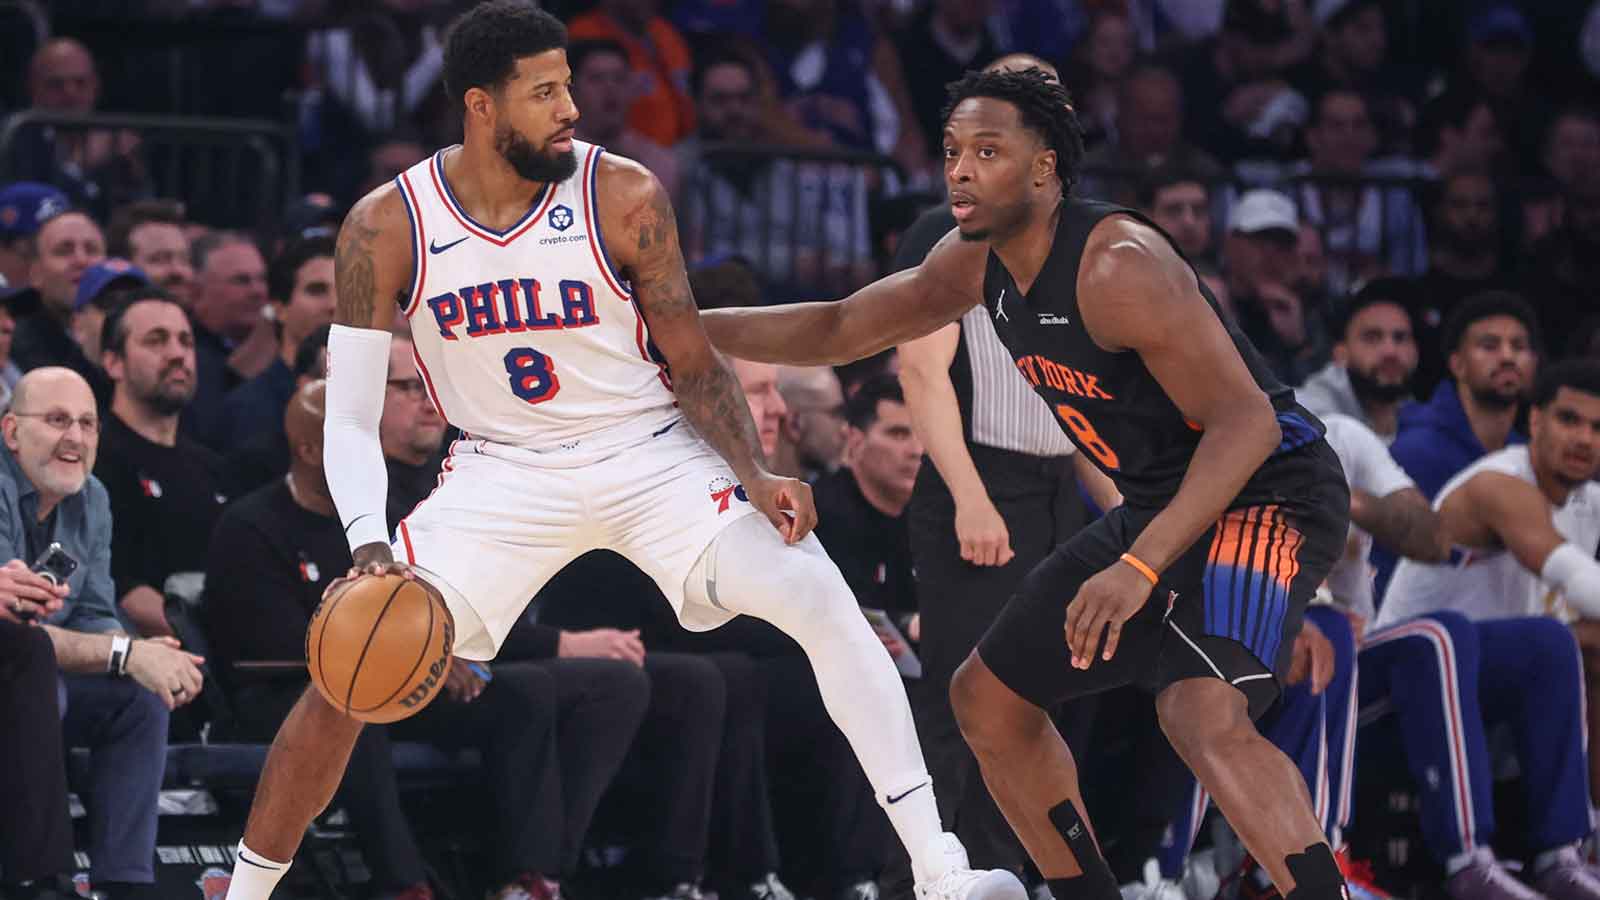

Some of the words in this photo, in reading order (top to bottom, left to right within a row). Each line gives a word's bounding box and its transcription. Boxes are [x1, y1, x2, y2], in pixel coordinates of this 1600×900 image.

[539, 234, 587, 246] crypto.com
[427, 278, 600, 340] PHILA
[503, 346, 561, 405] 8
[1035, 355, 1115, 400] YORK
[1056, 404, 1120, 470] 8
